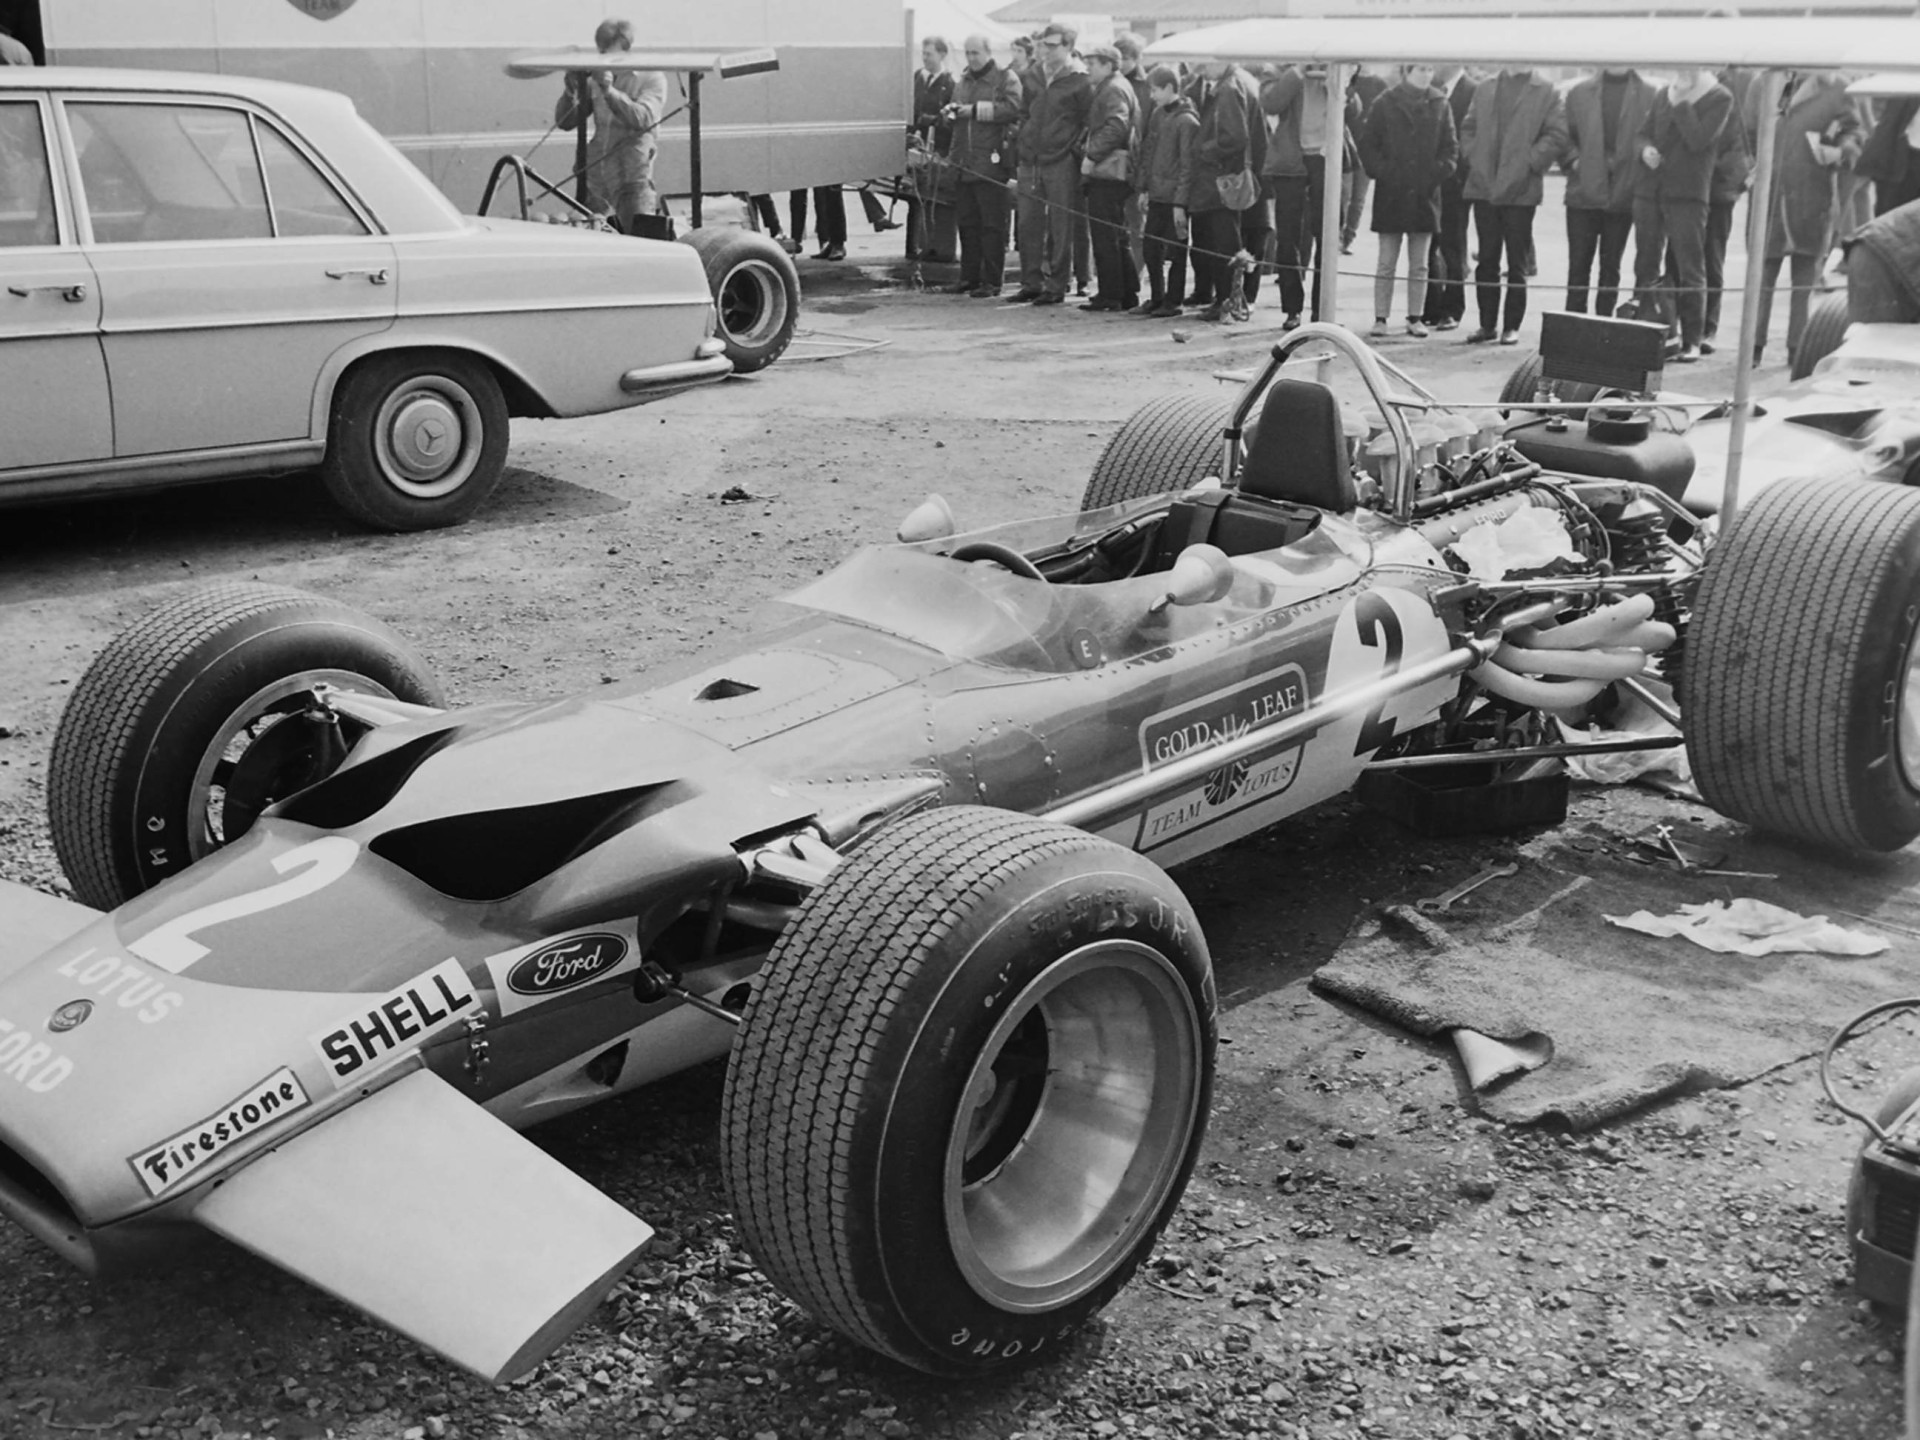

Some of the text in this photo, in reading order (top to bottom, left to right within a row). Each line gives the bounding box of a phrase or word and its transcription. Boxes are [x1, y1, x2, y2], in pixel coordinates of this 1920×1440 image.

[1080, 639, 1093, 658] E
[1353, 591, 1403, 762] 2
[1154, 685, 1298, 762] GOLD LEAF
[1150, 760, 1294, 837] TEAM LOTUS
[127, 836, 360, 975] 2
[57, 947, 184, 1024] LOTUS
[533, 942, 604, 987] Ford
[320, 974, 474, 1077] SHELL
[143, 1081, 295, 1184] Firestone
